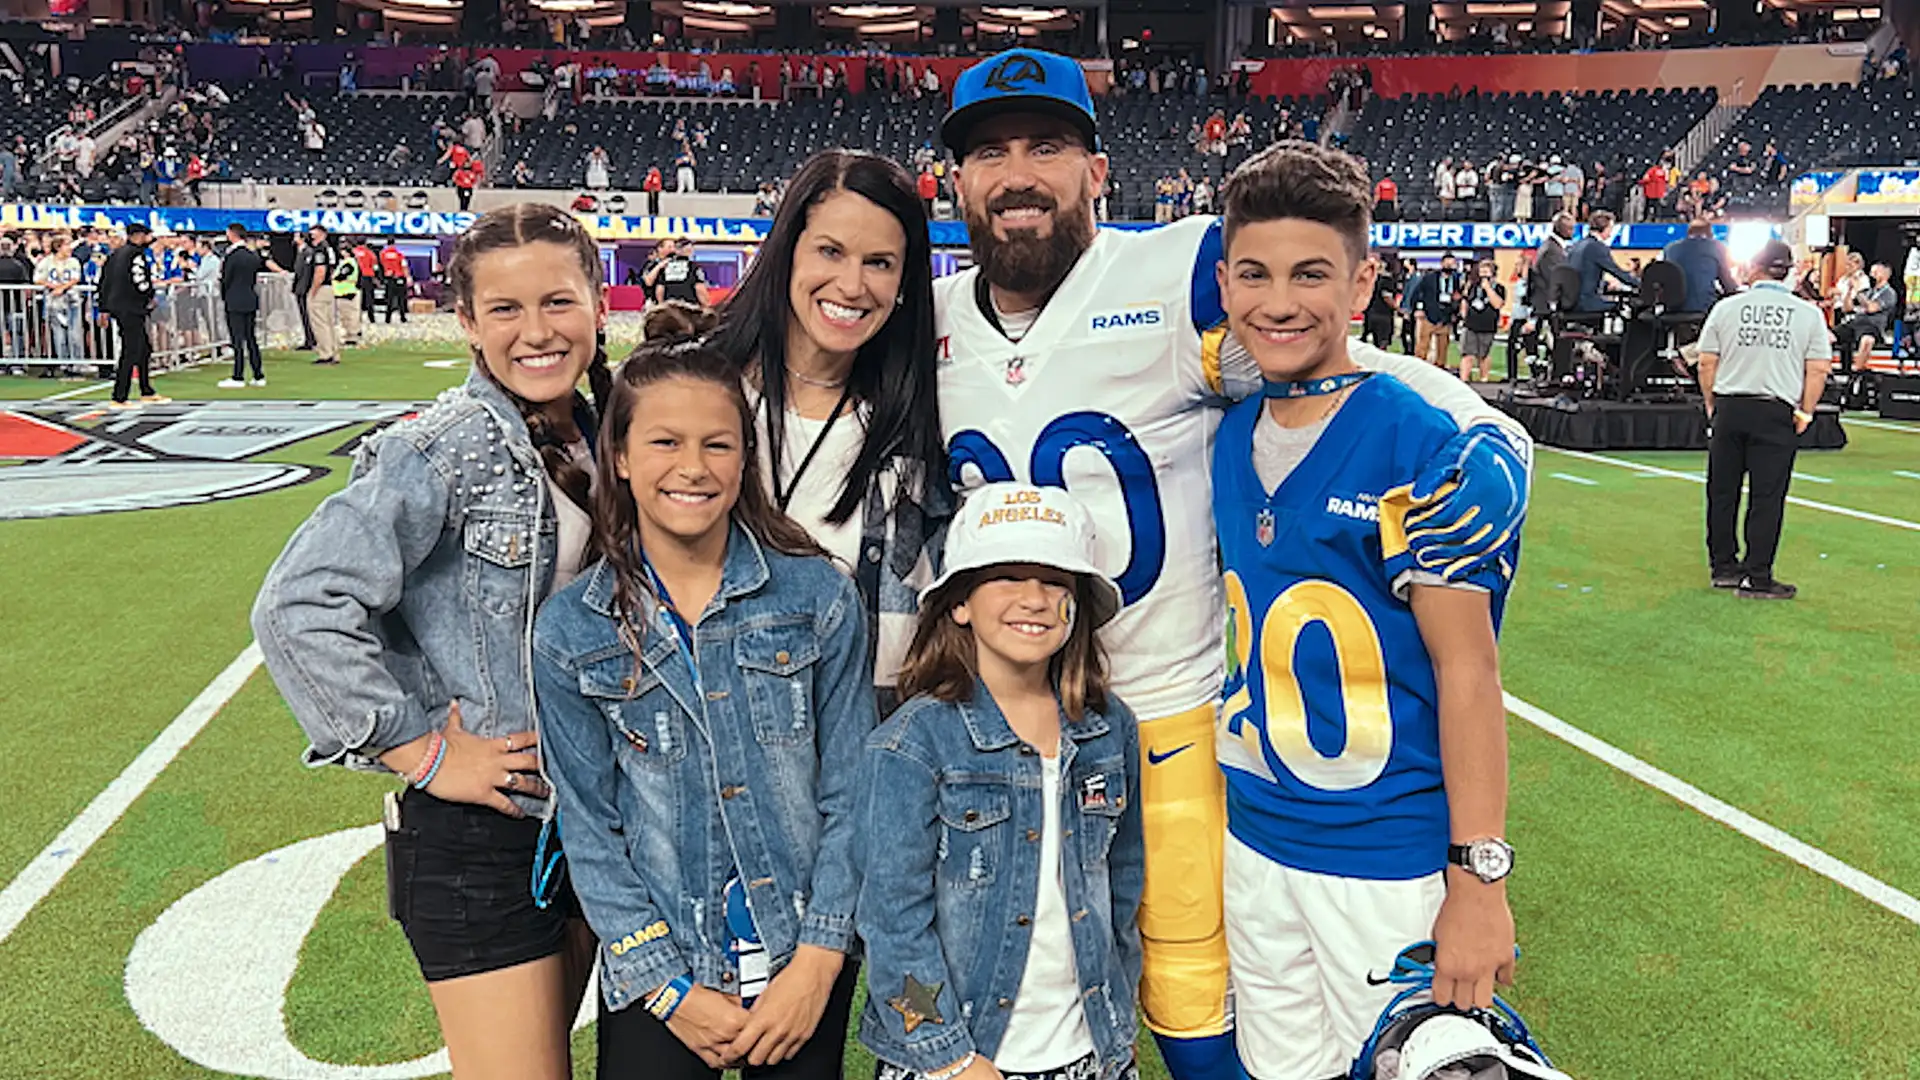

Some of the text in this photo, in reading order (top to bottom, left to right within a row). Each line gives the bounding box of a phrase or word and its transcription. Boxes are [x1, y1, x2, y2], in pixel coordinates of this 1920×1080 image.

[266, 209, 477, 234] CHAMPIONS
[1472, 223, 1581, 247] BOW
[1091, 310, 1161, 330] RAMS
[1740, 304, 1796, 326] GUEST
[1738, 326, 1791, 349] SERVICES
[1004, 490, 1042, 504] LOS
[978, 506, 1066, 529] ANGELES
[1327, 496, 1380, 522] RAM
[1214, 568, 1393, 792] 20
[610, 919, 671, 956] RAMS
